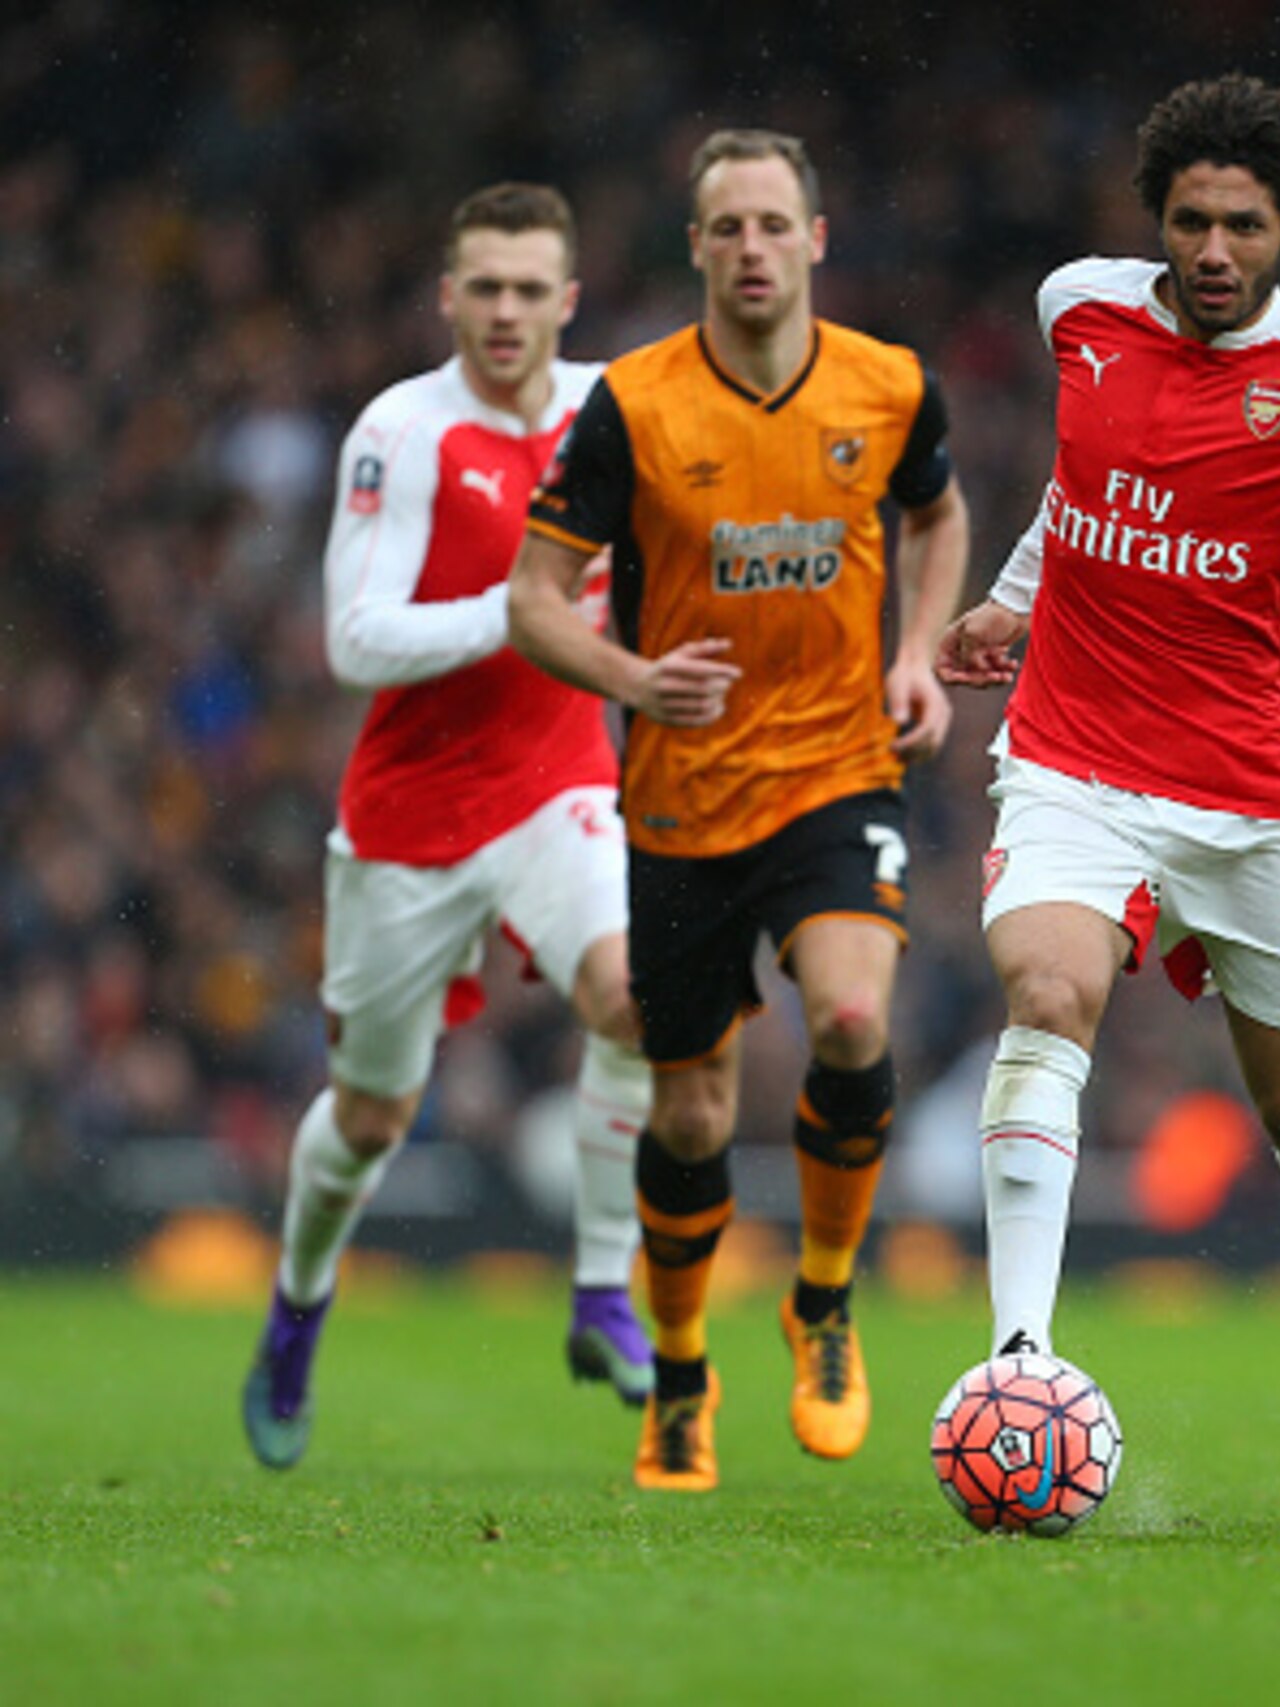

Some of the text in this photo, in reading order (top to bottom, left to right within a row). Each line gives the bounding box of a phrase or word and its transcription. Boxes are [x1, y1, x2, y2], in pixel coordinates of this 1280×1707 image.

[1105, 469, 1174, 522] Fly
[1046, 482, 1249, 583] Emirates
[714, 548, 842, 594] LAND
[863, 823, 907, 883] 7
